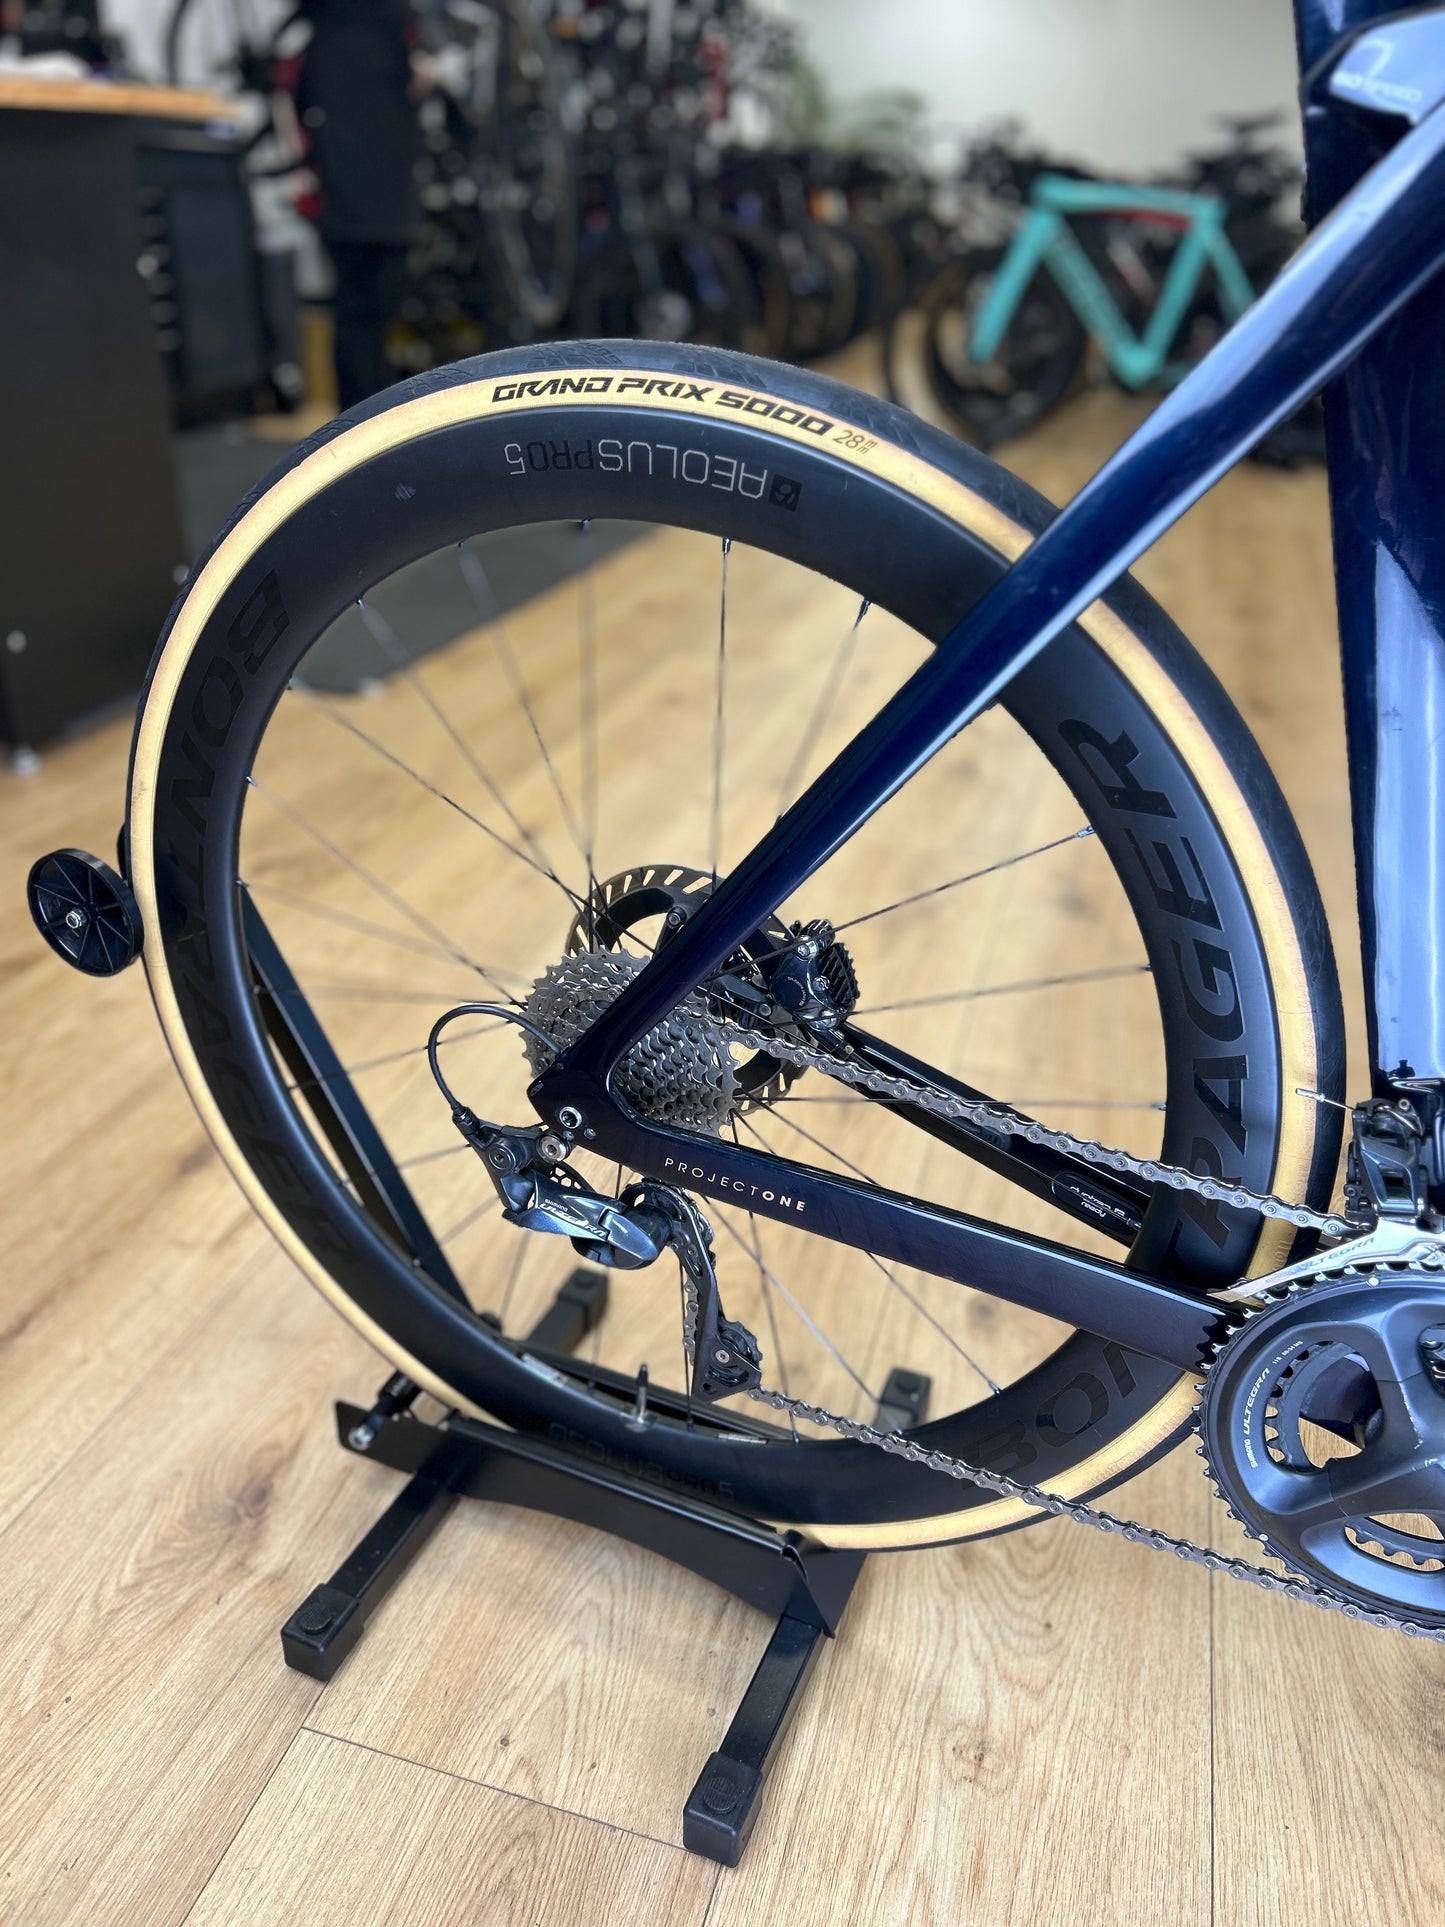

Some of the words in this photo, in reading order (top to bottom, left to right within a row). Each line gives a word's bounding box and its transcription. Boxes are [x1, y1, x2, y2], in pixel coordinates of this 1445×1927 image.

[492, 376, 614, 403] GRAND
[616, 377, 716, 402] PRIX
[715, 389, 836, 437] 5000
[1242, 1366, 1270, 1436] ULTEGRA
